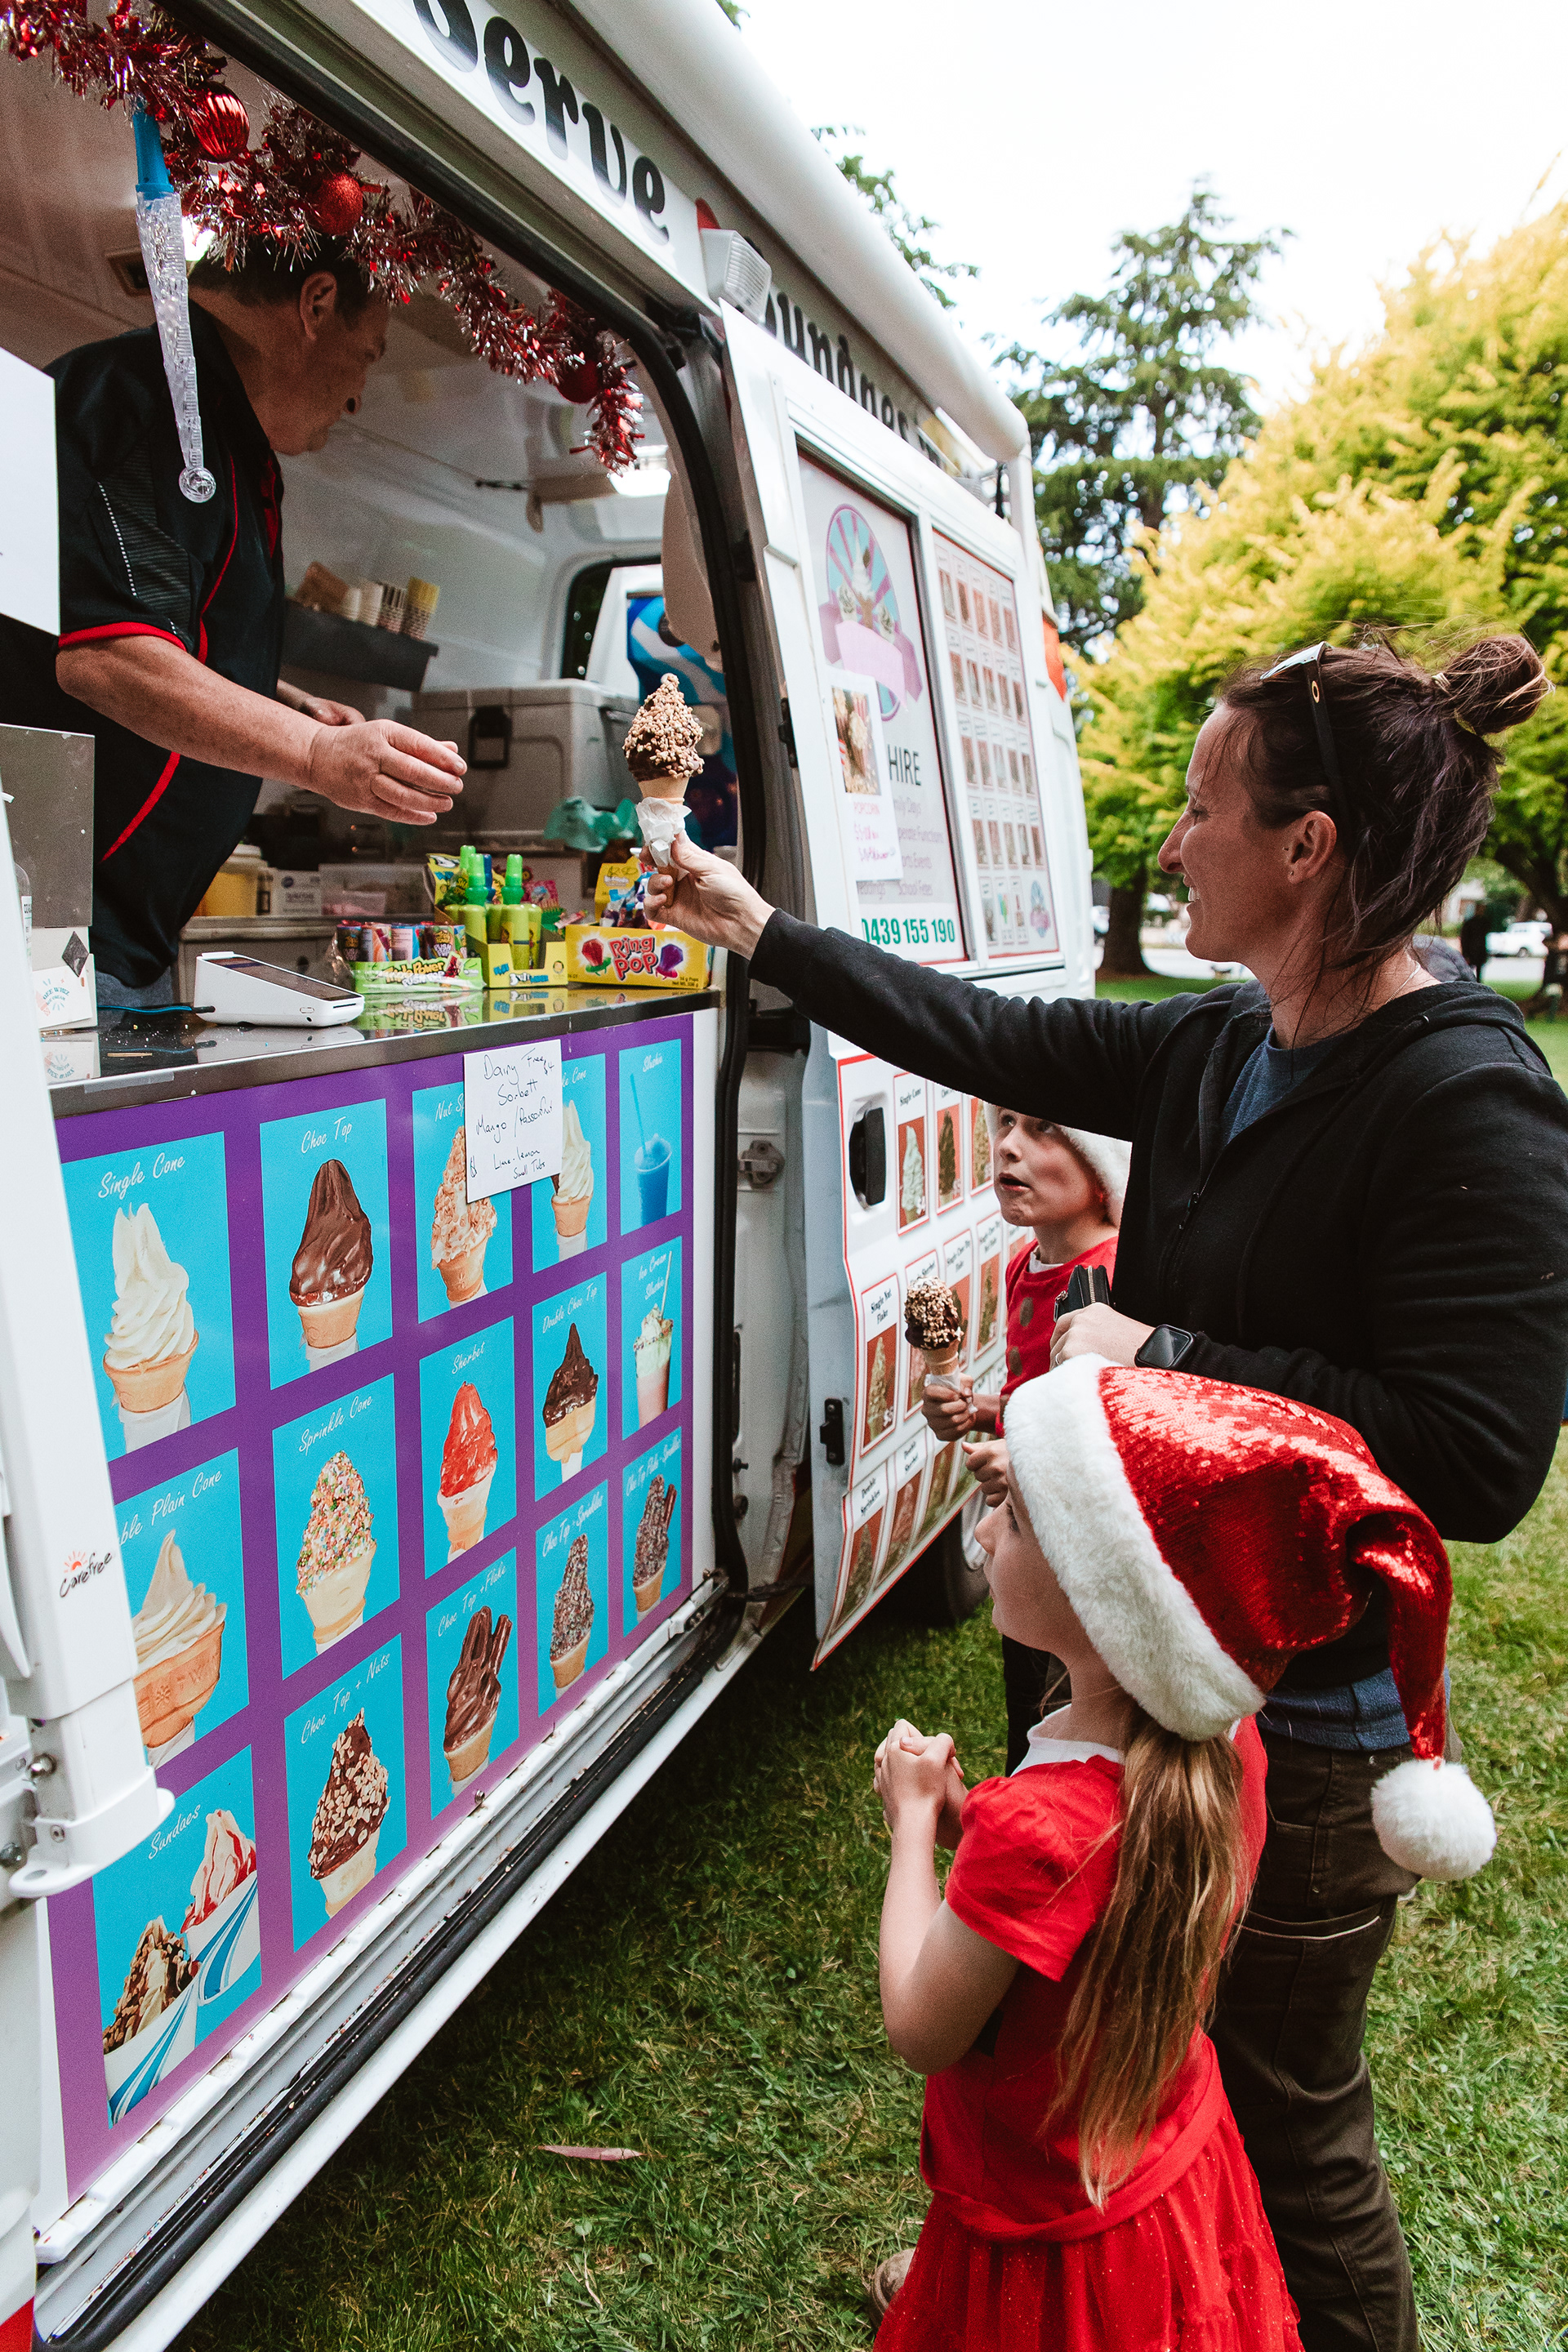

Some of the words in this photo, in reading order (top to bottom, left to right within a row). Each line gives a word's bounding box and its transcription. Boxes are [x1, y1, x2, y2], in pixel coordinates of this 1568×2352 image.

[888, 744, 922, 786] HIRE
[609, 936, 656, 960] Ring
[902, 918, 929, 944] 155
[932, 919, 956, 942] 190
[484, 1054, 519, 1085] Dairy
[572, 1067, 586, 1084] Cone
[435, 1100, 452, 1122] Nut
[476, 1114, 507, 1143] Mango
[301, 1129, 327, 1154] Choc
[333, 1116, 353, 1143] Top
[98, 1161, 145, 1200] Single
[153, 1152, 186, 1178] Cone
[542, 1306, 564, 1334] Double
[567, 1297, 582, 1315] Choc
[586, 1282, 598, 1302] Top
[451, 1341, 485, 1374] Sherbet
[299, 1407, 345, 1456] Sprinkle
[350, 1396, 373, 1419] Cone
[119, 1513, 143, 1546] ble
[151, 1491, 185, 1526] Plain
[192, 1470, 222, 1498] Cone
[559, 1518, 570, 1545] Top
[59, 1552, 113, 1598] Carefree
[438, 1611, 457, 1637] Choc
[462, 1590, 477, 1614] Top
[301, 1713, 327, 1744] Choc
[332, 1687, 351, 1715] Top
[366, 1653, 390, 1684] Nuts
[148, 1804, 201, 1860] Sundaes
